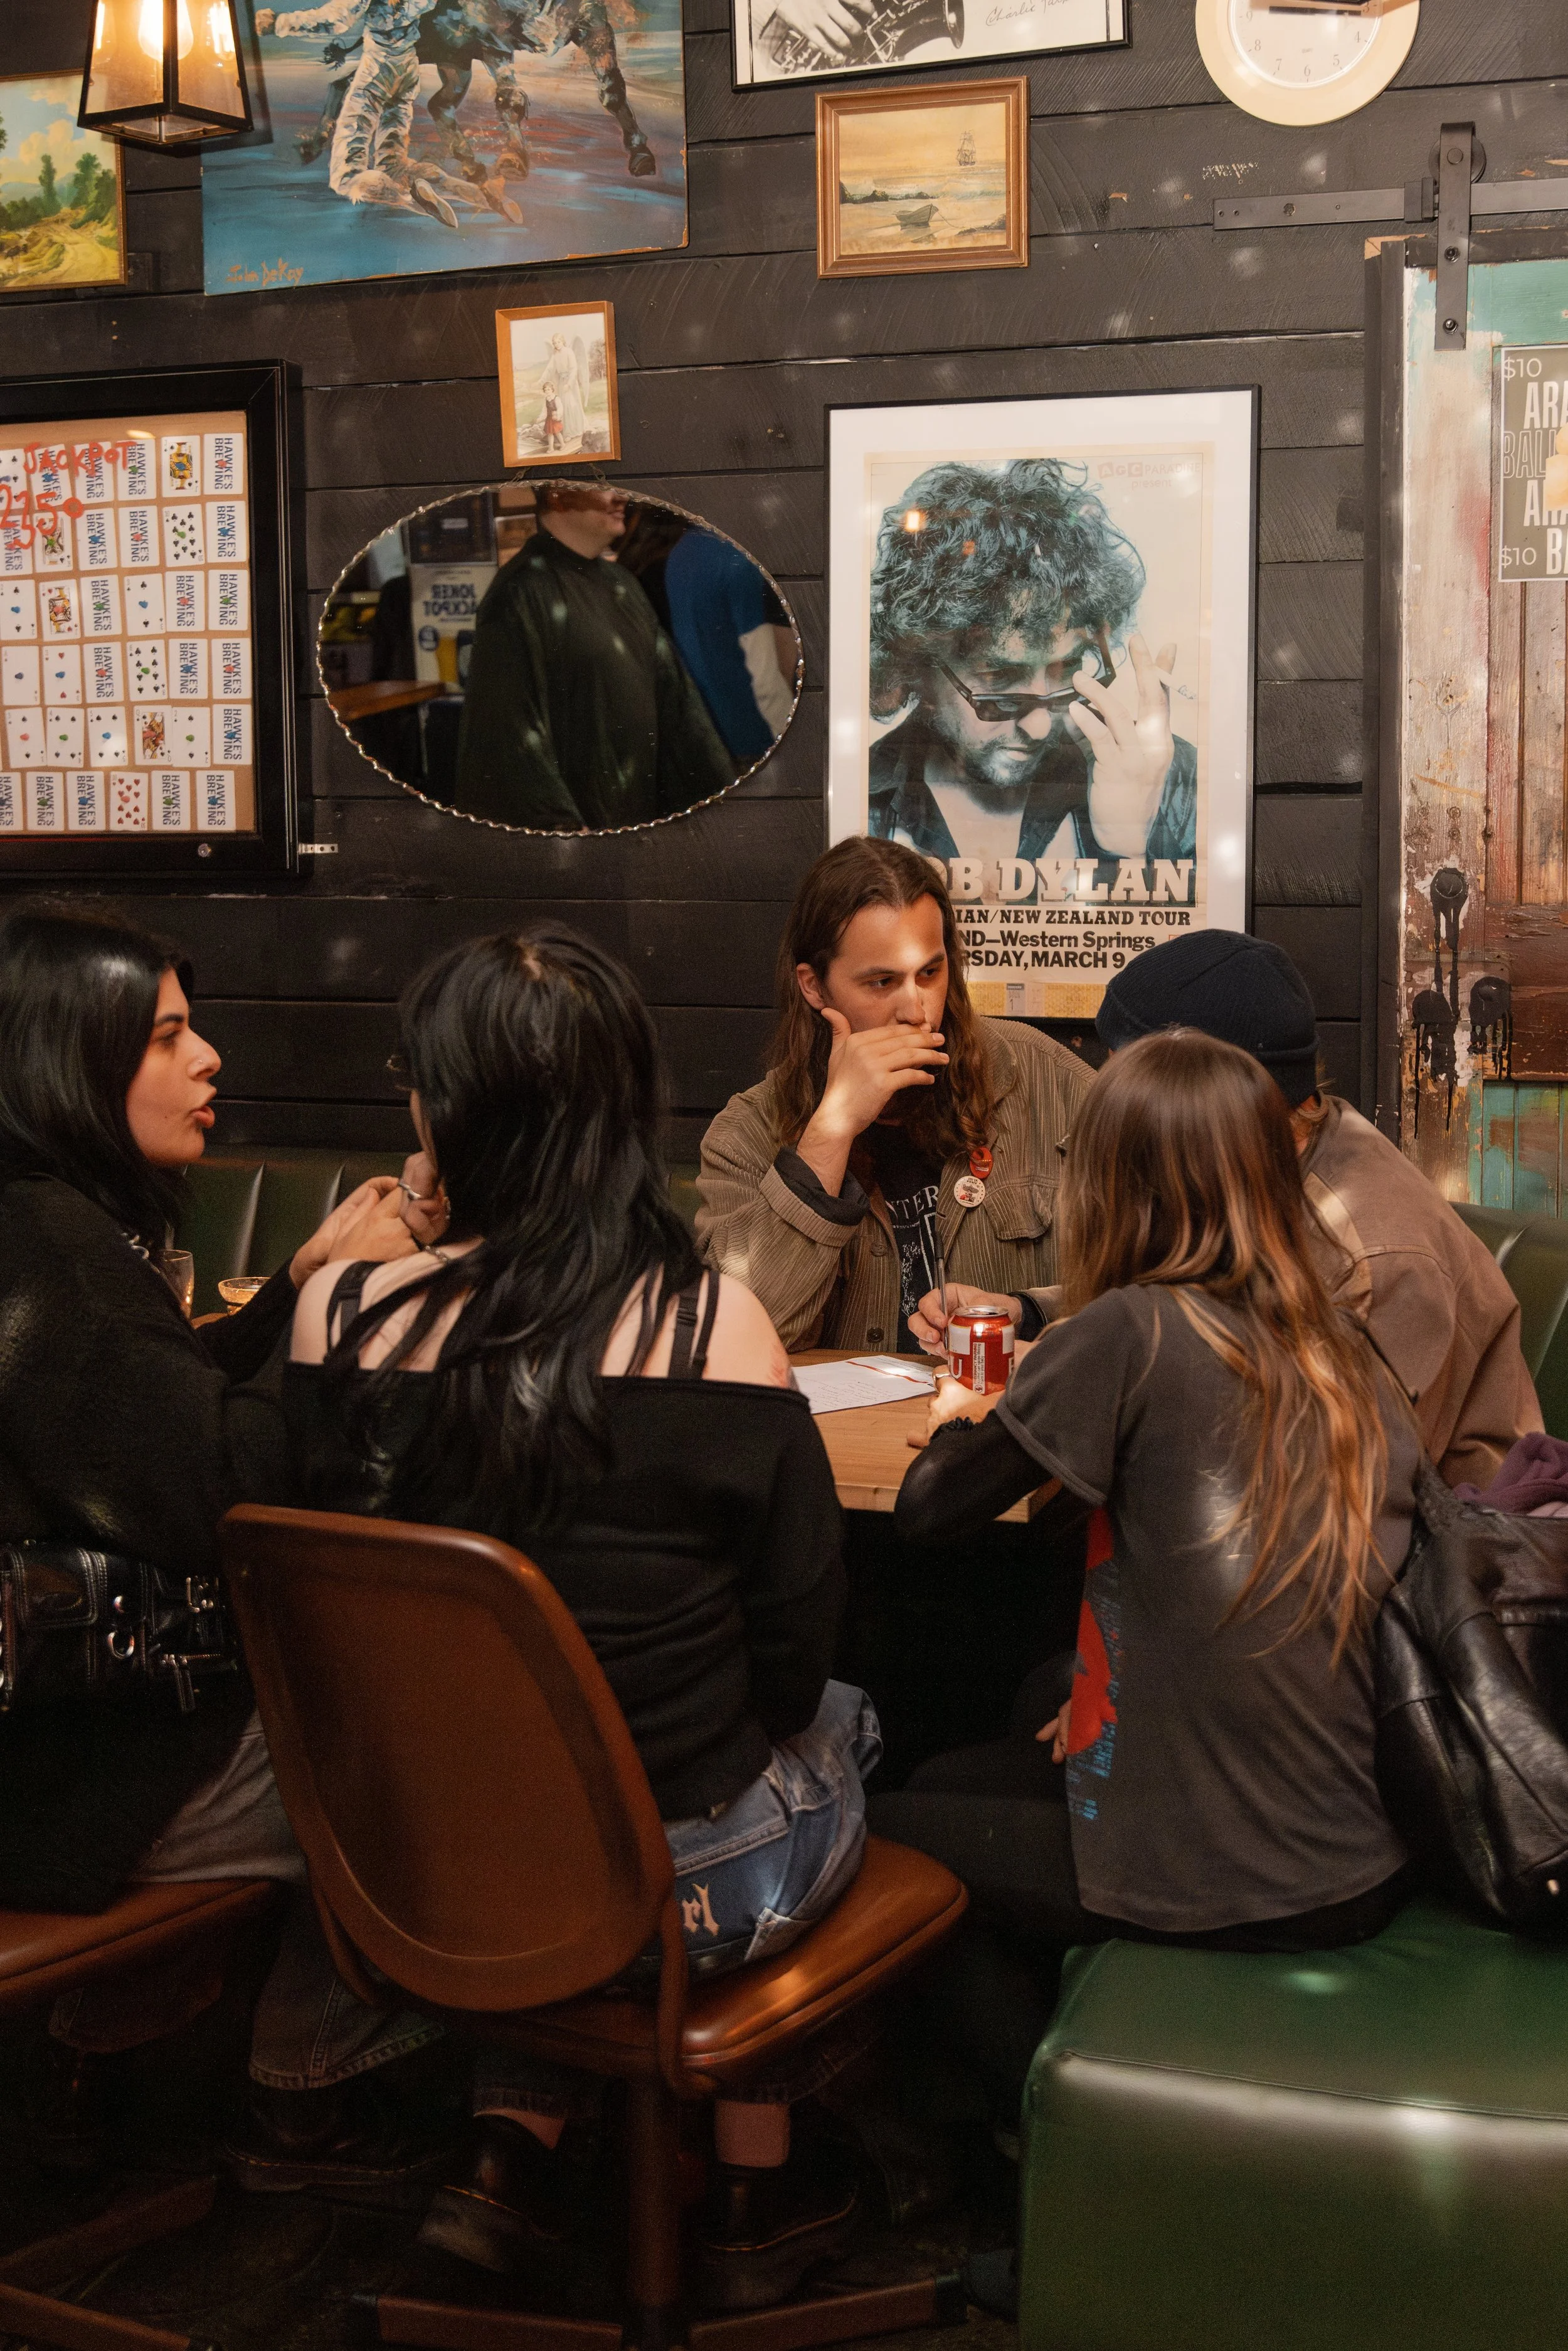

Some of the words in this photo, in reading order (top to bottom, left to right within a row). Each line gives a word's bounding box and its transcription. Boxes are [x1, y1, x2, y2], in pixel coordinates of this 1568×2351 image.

[1254, 40, 1261, 51] 8
[1354, 31, 1360, 43] 4
[1276, 58, 1282, 71] 7
[1333, 55, 1340, 66] 5
[1304, 65, 1311, 77] 6
[1503, 356, 1542, 381] $10
[23, 442, 137, 478] JACKPOT
[1131, 479, 1172, 491] present
[1502, 545, 1537, 568] $10
[997, 857, 1193, 902] DYLAN
[956, 909, 1041, 924] IAN/NEW
[1046, 910, 1134, 926] ZEALAND
[1139, 910, 1191, 926] TOUR
[1083, 930, 1156, 952] Springs
[1032, 950, 1107, 969] MARCH
[1112, 950, 1126, 969] 9
